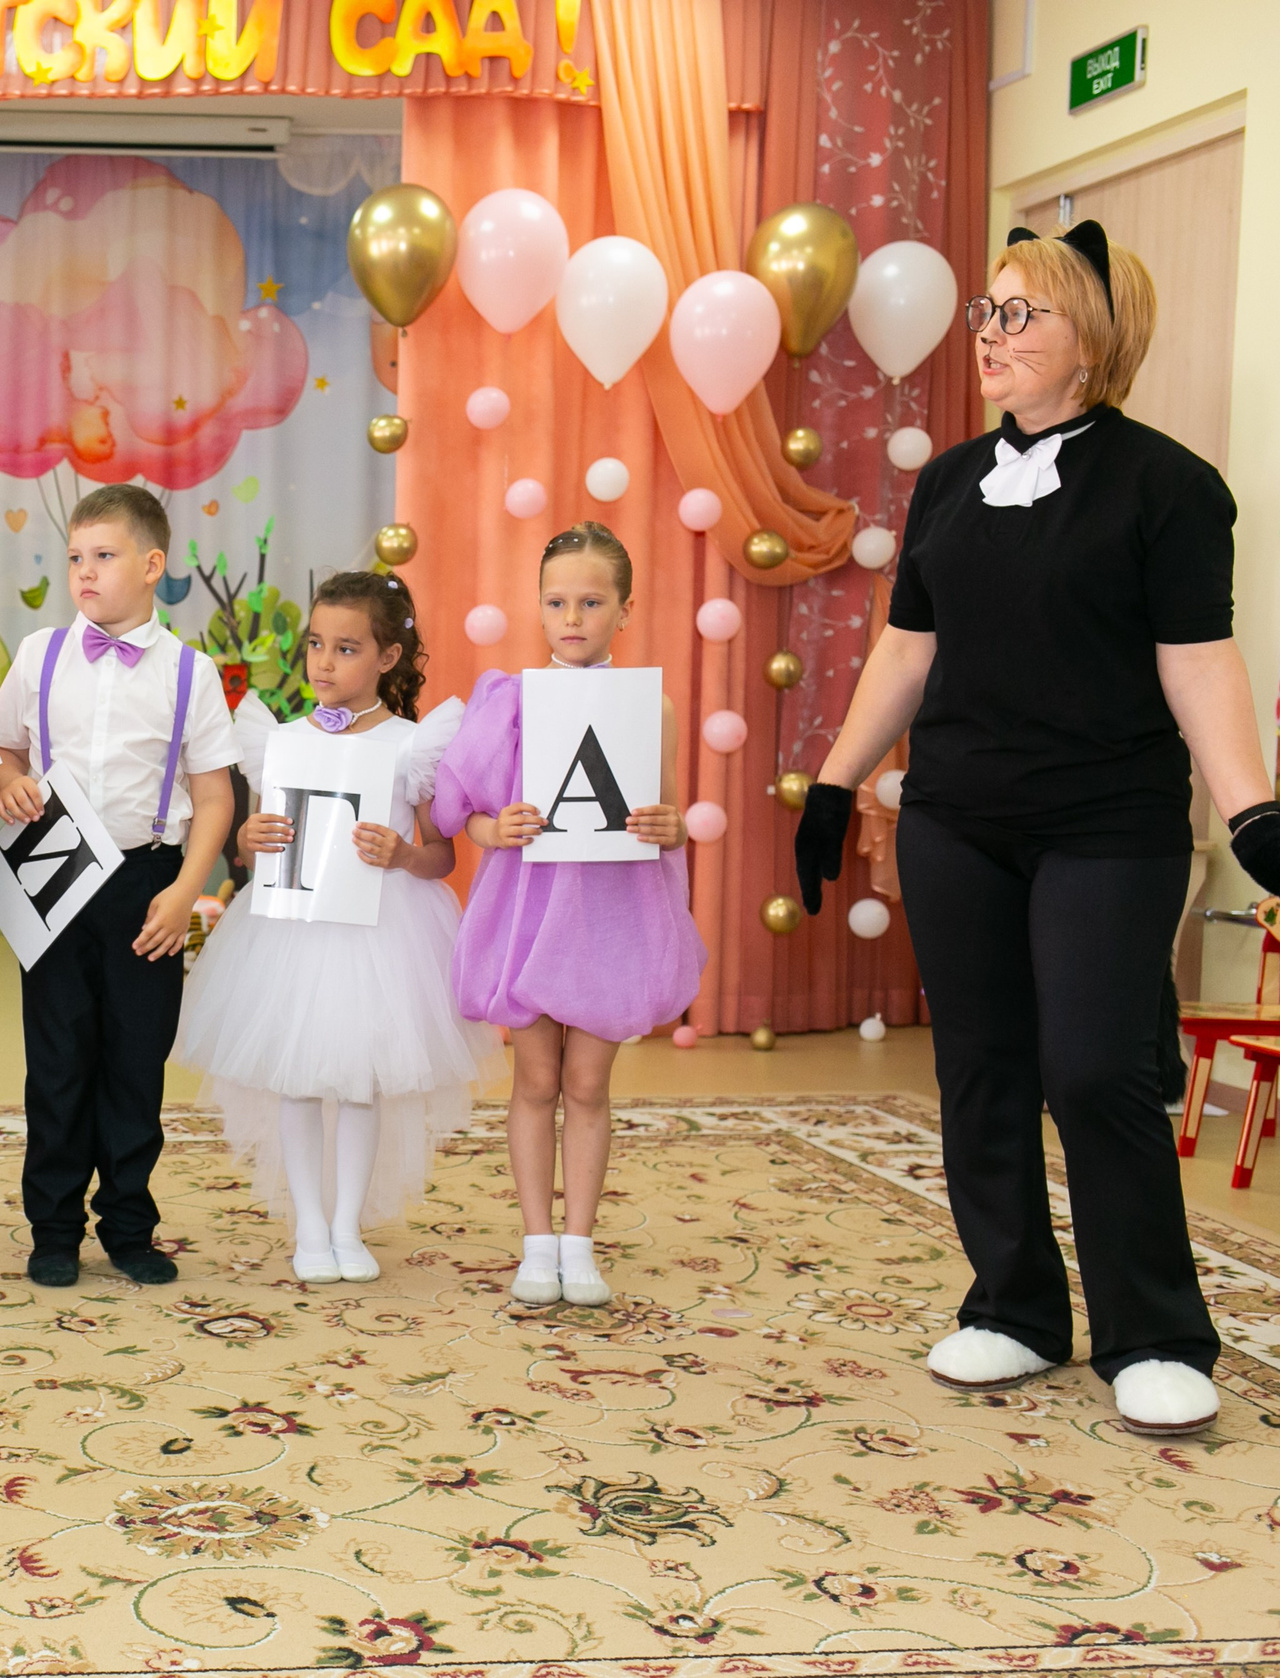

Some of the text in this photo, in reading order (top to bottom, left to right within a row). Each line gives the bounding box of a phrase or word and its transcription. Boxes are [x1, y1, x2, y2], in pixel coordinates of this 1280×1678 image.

[1086, 46, 1120, 79] ВЫХОД
[1092, 72, 1114, 95] EXIT
[540, 724, 634, 833] А
[263, 786, 362, 892] Г
